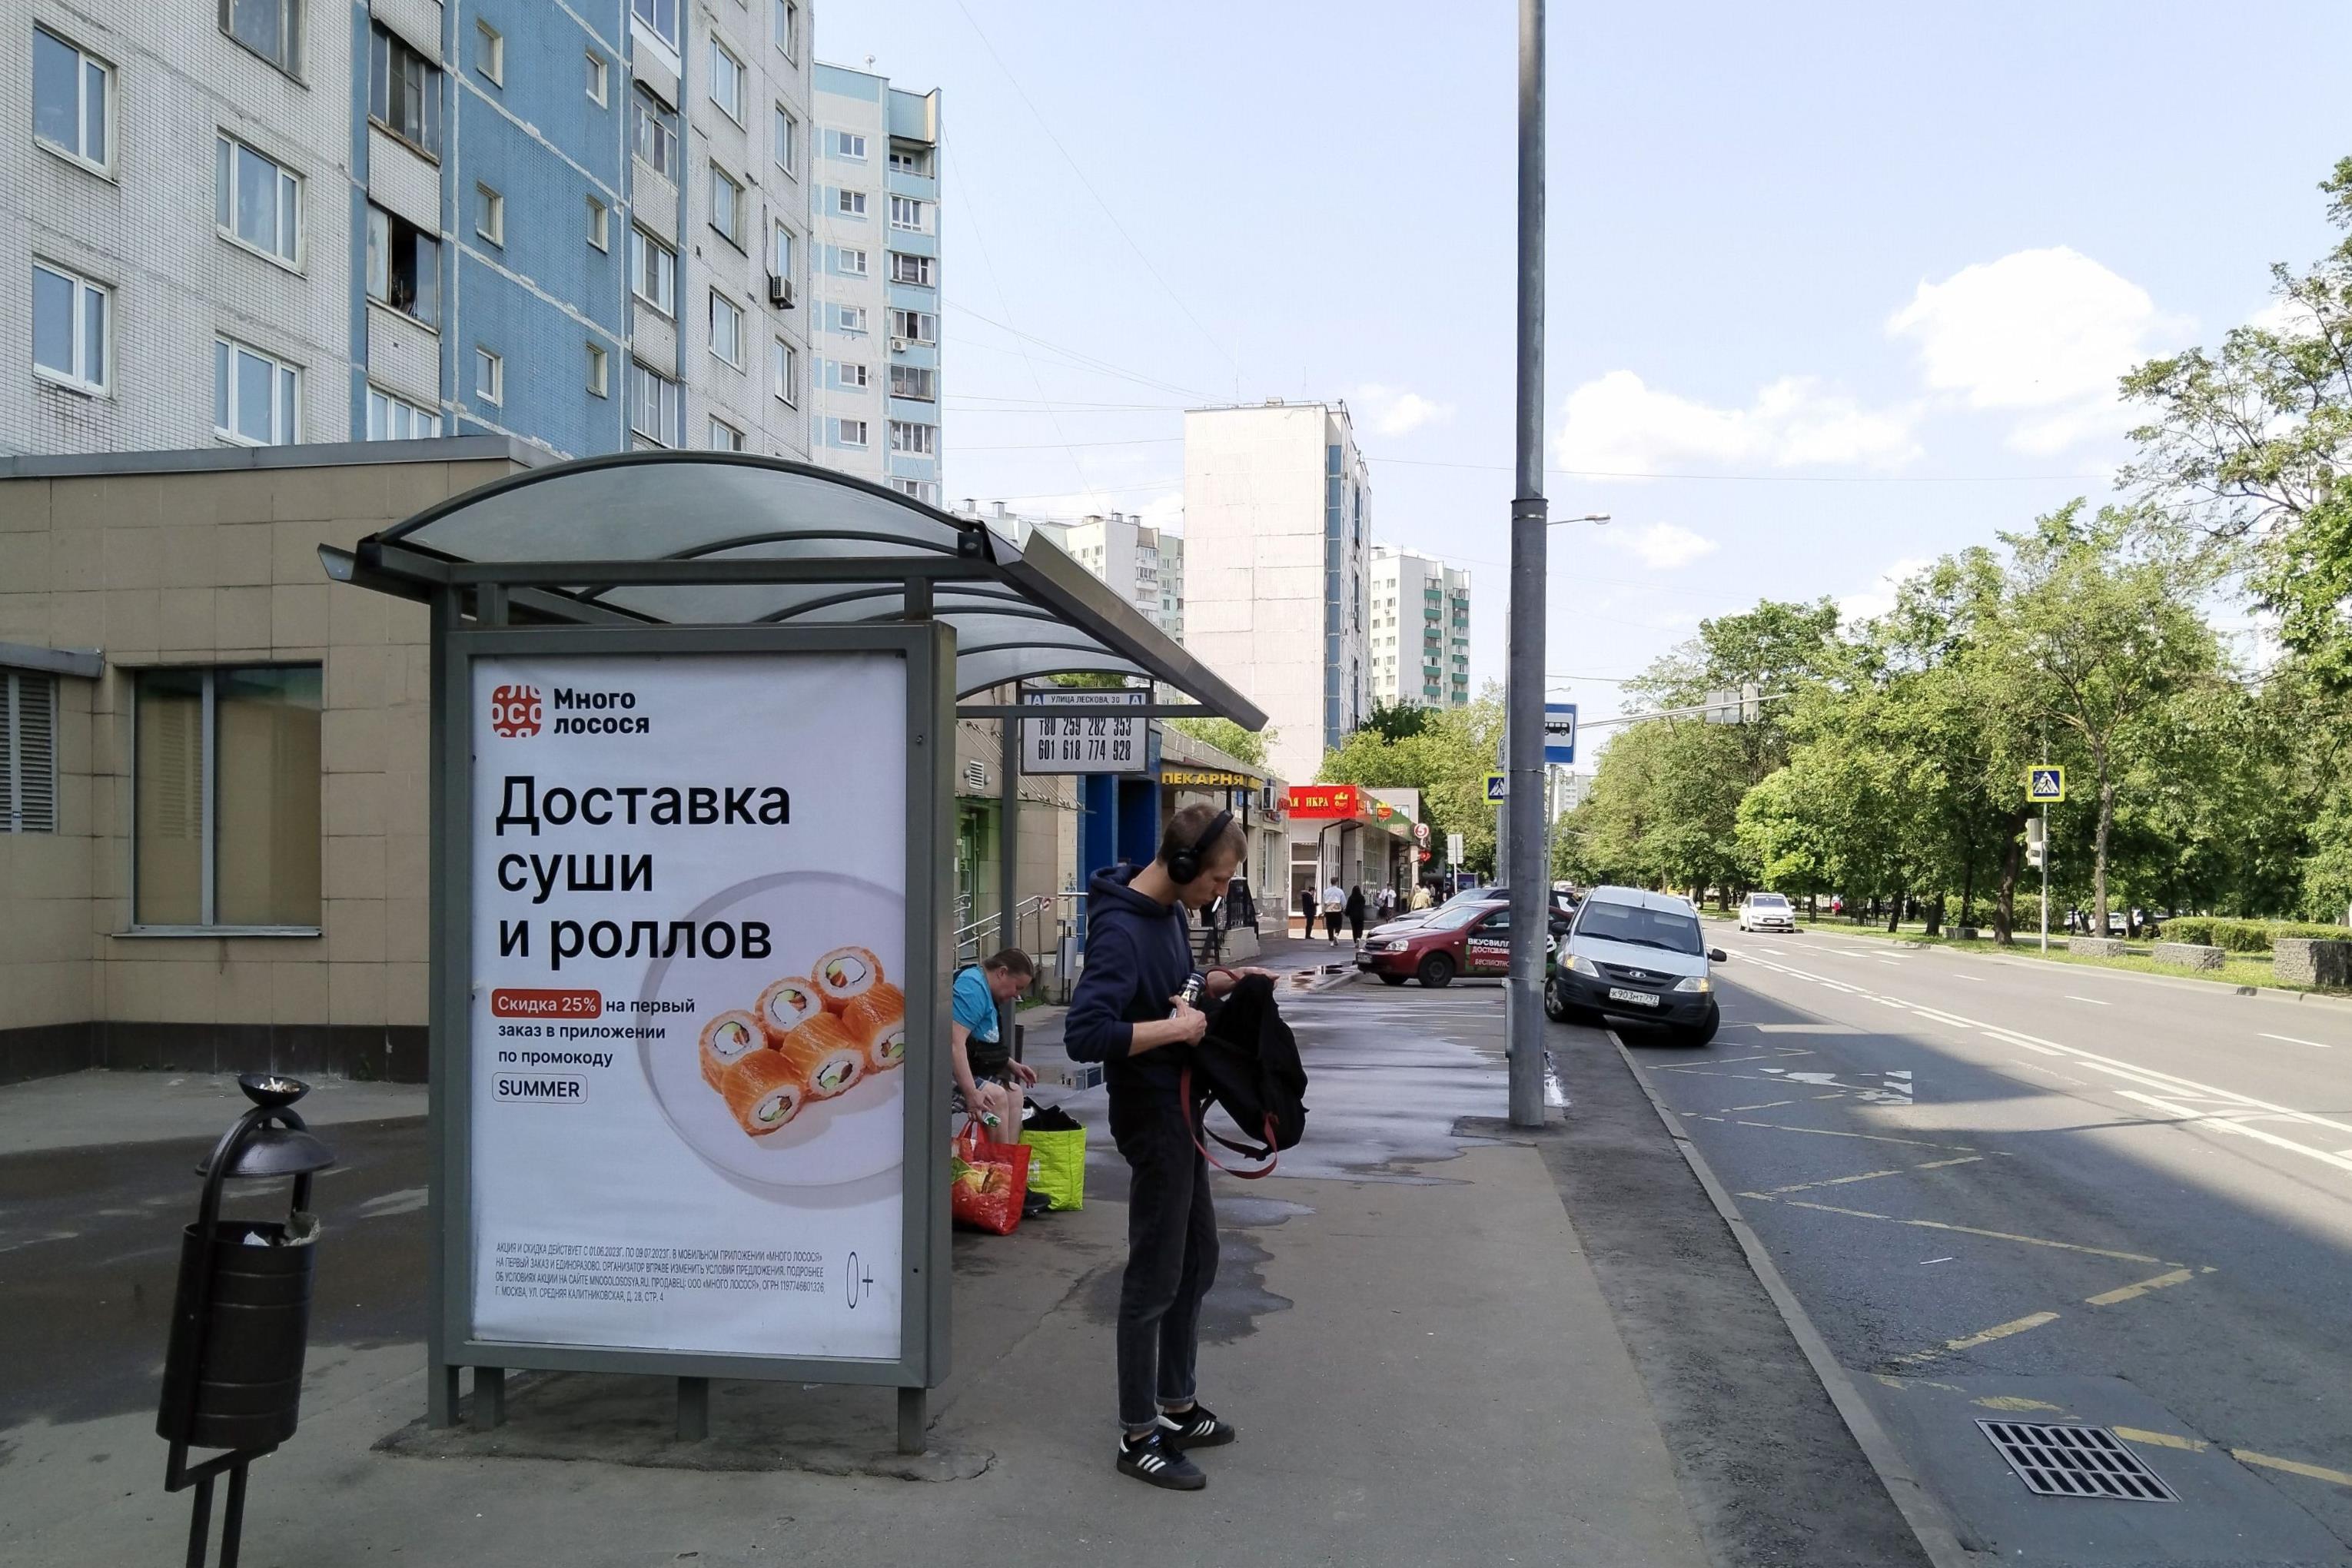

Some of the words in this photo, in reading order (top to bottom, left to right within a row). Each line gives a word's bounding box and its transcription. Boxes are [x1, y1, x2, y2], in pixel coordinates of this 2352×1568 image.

[553, 688, 636, 709] Много
[1051, 696, 1075, 704] УЛИЦА
[1076, 696, 1109, 704] ЛЕСКОВА,
[553, 717, 649, 734] лосося
[1063, 717, 1081, 736] 259
[1088, 717, 1106, 736] 282
[1114, 717, 1131, 736] 353
[1038, 739, 1055, 760] 601
[1063, 739, 1081, 760] 618
[1088, 740, 1106, 760] 774
[1113, 740, 1131, 761] 928
[1161, 772, 1244, 786] ПЕКАРНЯ
[496, 776, 790, 836] Доставка
[497, 853, 653, 905] суши
[500, 920, 529, 957] и
[550, 920, 772, 971] роллов
[498, 996, 557, 1013] Скидка
[561, 998, 596, 1012] 25%
[606, 1002, 625, 1012] на
[630, 998, 696, 1016] первый
[498, 1025, 542, 1038] заказ
[546, 1027, 555, 1038] в
[560, 1026, 666, 1041] приложении
[498, 1051, 517, 1062] по
[521, 1052, 613, 1068] промокоду
[498, 1080, 580, 1098] SUMMER
[497, 1242, 517, 1254] АКЦИЯ
[517, 1243, 522, 1254] И
[523, 1243, 547, 1256] СКИДКА
[548, 1243, 583, 1256] ДЕЙСТВУЕТ
[583, 1245, 588, 1256] С
[626, 1247, 635, 1258] ПО
[673, 1248, 678, 1260] В
[678, 1249, 719, 1261] МОБИЛЬНОМ
[719, 1250, 765, 1261] ПРИЛОЖЕНИИ
[496, 1257, 504, 1267] НА
[505, 1256, 530, 1269] ПЕРВЫЙ
[530, 1257, 550, 1270] ЗАКАЗ
[550, 1259, 555, 1270] И
[603, 1261, 645, 1273] ОРГАНИЗАТОР
[646, 1262, 669, 1274] ВПРАВЕ
[670, 1263, 705, 1274] ИЗМЕНИТЬ
[706, 1264, 736, 1275] УСЛОВИЯ
[736, 1264, 786, 1277] ПРЕДЛОЖЕНИЯ.
[786, 1266, 824, 1278] ПОДРОБНЕЕ
[495, 1271, 504, 1282] ОБ
[504, 1272, 537, 1284] УСЛОВИЯХ
[537, 1273, 558, 1285] АКЦИИ
[559, 1274, 568, 1284] НА
[569, 1273, 589, 1285] САЙТЕ
[687, 1278, 702, 1289] ООО
[762, 1280, 779, 1291] ОГРН
[846, 1251, 874, 1310] 0+
[501, 1286, 528, 1299] МОСКВА,
[540, 1287, 567, 1300] СРЕДНЯЯ
[659, 1291, 664, 1302] 4
